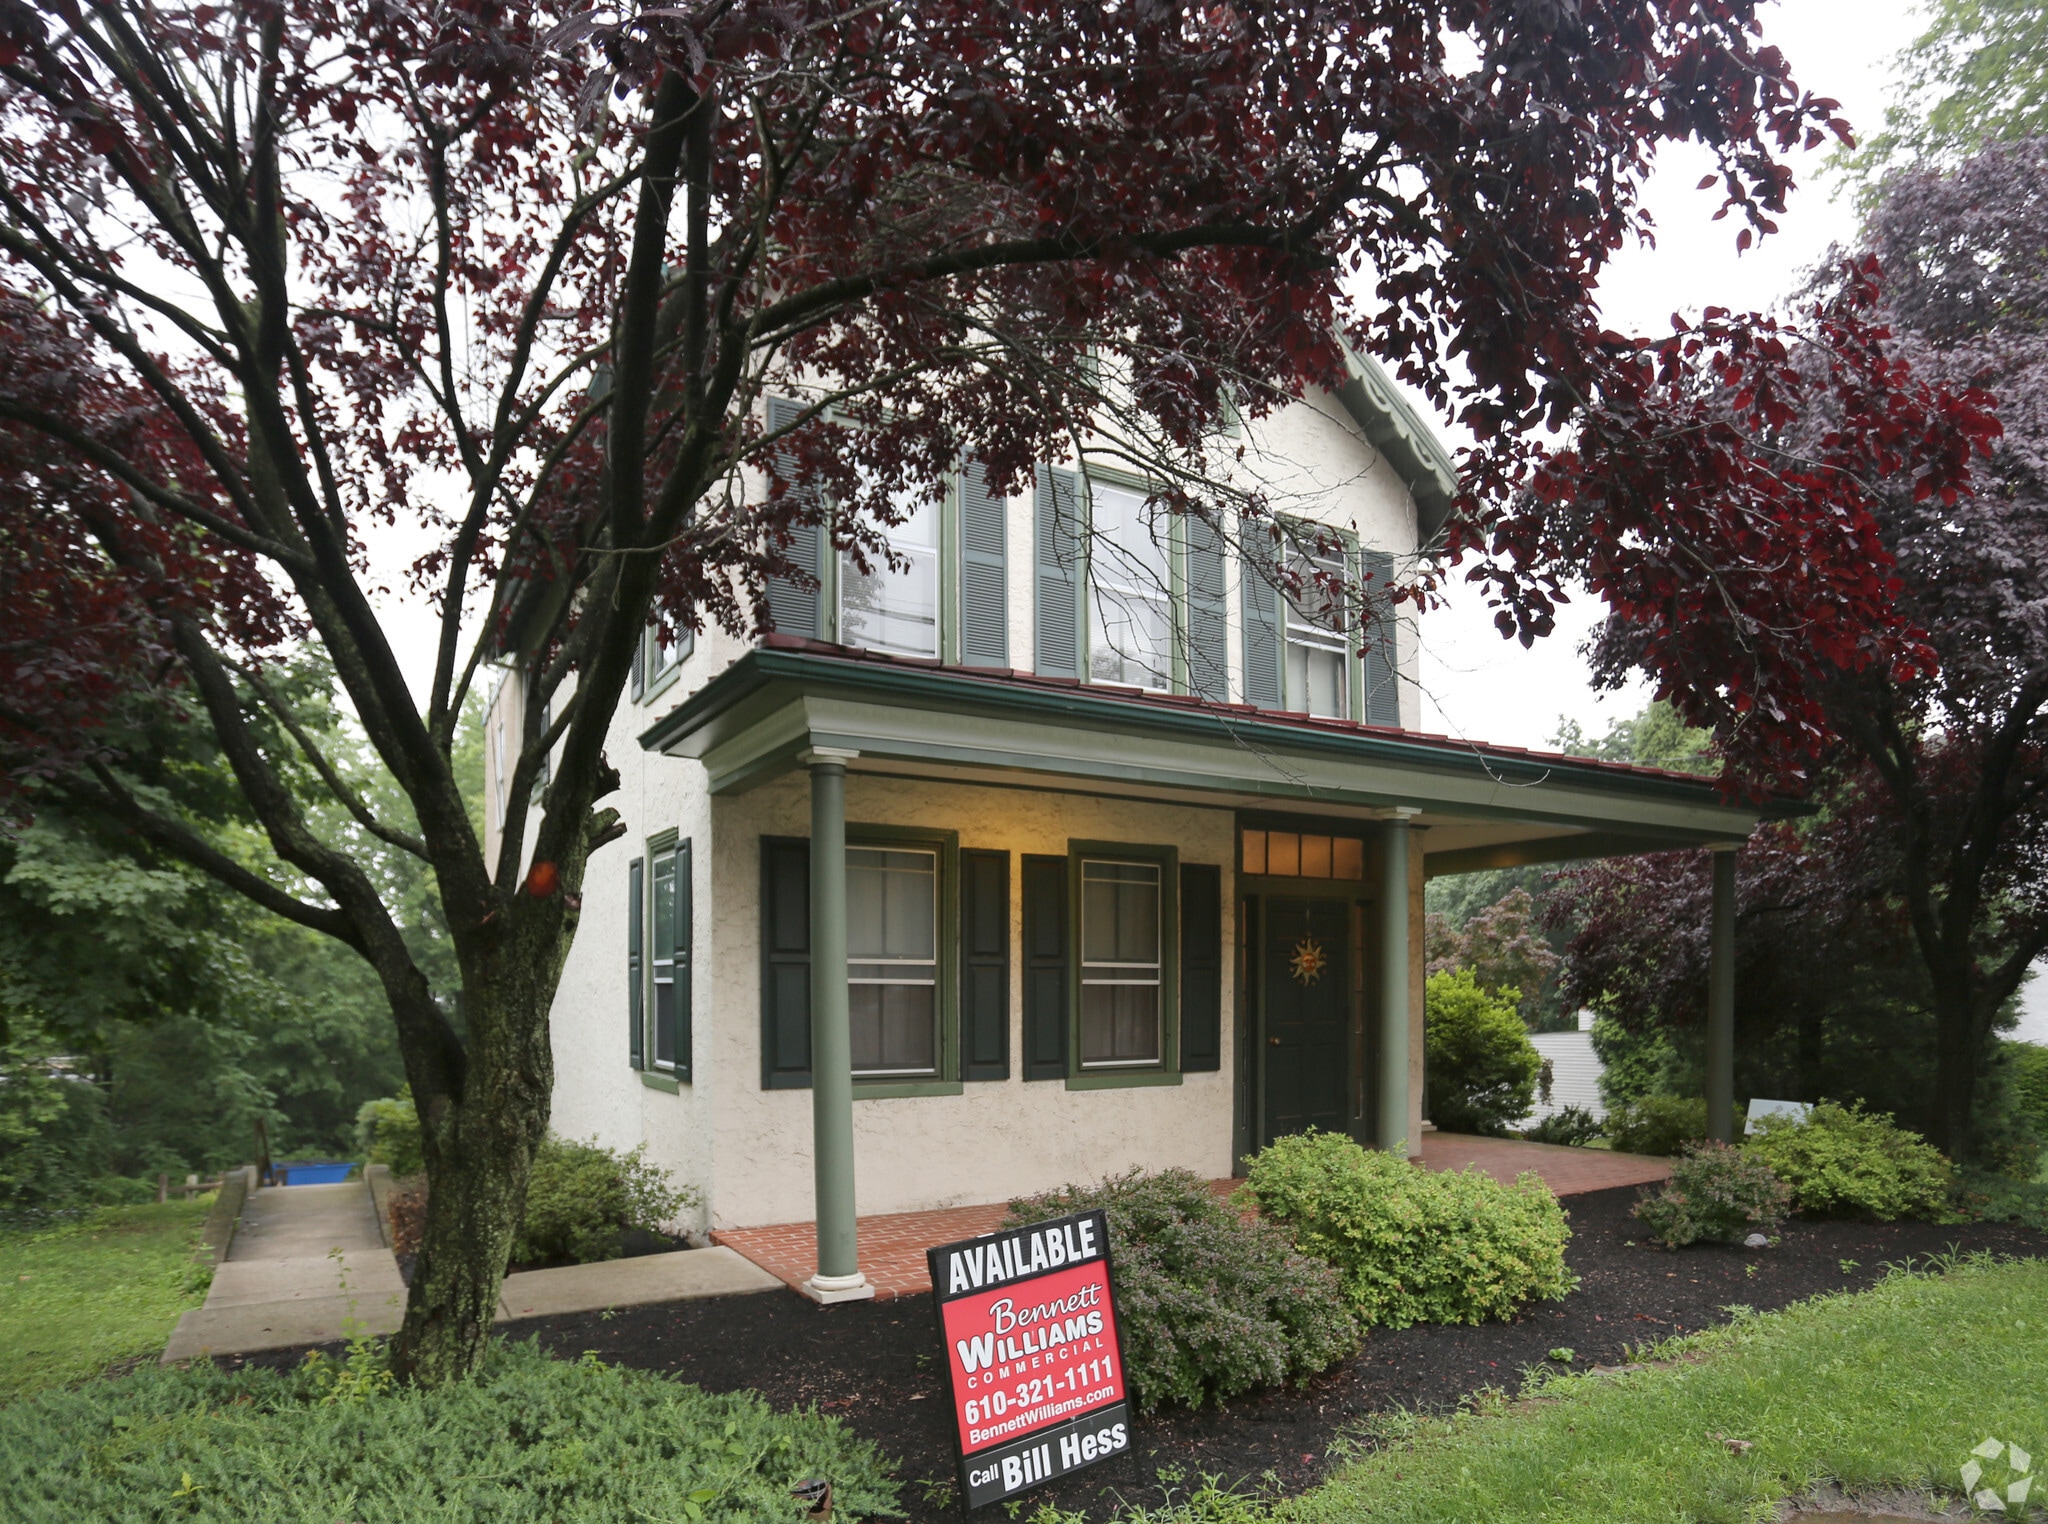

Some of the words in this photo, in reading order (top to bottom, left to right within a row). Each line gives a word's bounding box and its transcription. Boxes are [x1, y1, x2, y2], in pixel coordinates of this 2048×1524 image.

[950, 1219, 1097, 1294] AVAILABLE
[989, 1283, 1102, 1335] Bennett
[957, 1311, 1104, 1373] WILLIAMS
[967, 1338, 1103, 1389] COMMERCIAL
[965, 1355, 1113, 1425] 610-321-1111
[969, 1386, 1114, 1445] BennettWilliams.com
[969, 1463, 1000, 1487] Call
[1001, 1443, 1051, 1492] Bill
[1060, 1423, 1127, 1470] Hess
